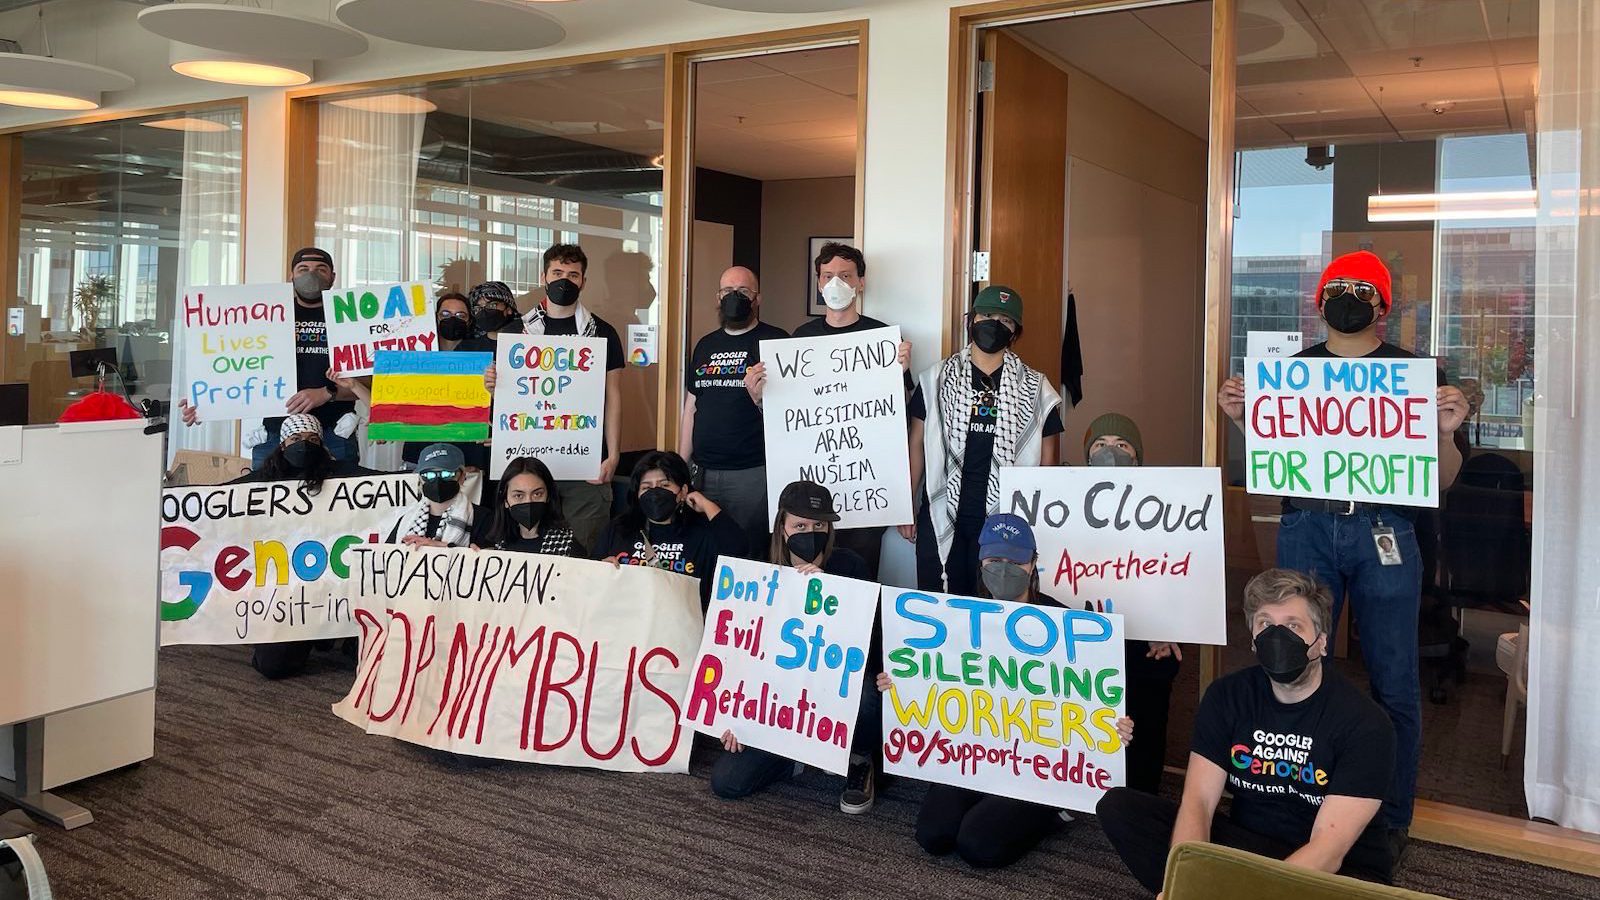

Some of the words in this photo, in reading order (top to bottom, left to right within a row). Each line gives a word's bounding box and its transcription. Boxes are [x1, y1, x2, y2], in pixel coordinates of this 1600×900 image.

[184, 293, 286, 328] Human
[333, 291, 379, 324] NO
[383, 284, 427, 319] AI
[202, 332, 268, 355] Lives
[369, 324, 390, 335] FOR
[508, 342, 595, 372] GOOGLE:
[708, 358, 745, 367] AGAINST
[710, 351, 748, 360] GOOGLER
[775, 348, 815, 379] WE
[830, 339, 897, 374] STAND
[191, 376, 286, 407] Profit
[516, 375, 572, 396] STOP
[722, 379, 747, 388] APARTHE
[813, 382, 848, 396] WITH
[1256, 360, 1310, 391] NO
[1322, 361, 1410, 396] MORE
[499, 413, 597, 432] RETALIATION
[535, 400, 557, 410] the
[784, 394, 897, 432] PALESTINIAN,
[1251, 395, 1429, 439] GENOCIDE
[814, 425, 864, 454] ARAB,
[970, 423, 985, 432] FOR
[505, 443, 590, 460] go/support-eddie
[799, 458, 876, 485] MUSLIM
[1250, 450, 1312, 492] FOR
[1323, 450, 1438, 498] PROFIT
[161, 480, 313, 523] OOGLERS
[328, 476, 423, 512] AGAIN
[832, 487, 889, 514] GLERS
[1010, 489, 1070, 529] No
[1083, 481, 1213, 533] Cloud
[161, 525, 378, 622] Genoc
[441, 552, 561, 605] KURIAN:
[1053, 547, 1192, 596] Apartheid
[715, 564, 780, 607] Don't
[804, 577, 839, 616] Be
[235, 586, 351, 639] go/sit-in
[895, 591, 1114, 664] STOP
[713, 608, 765, 661] Evil,
[775, 617, 865, 698] Stop
[427, 621, 682, 767] NIMBUS
[888, 647, 1124, 708] SILENCING
[686, 653, 848, 749] Retaliation
[889, 682, 1122, 755] WORKERS
[1251, 744, 1310, 765] AGAINST
[1252, 729, 1313, 751] GOOGLER
[884, 727, 1114, 790] go/support-eddie
[1230, 743, 1329, 786] Genocide
[1266, 785, 1286, 794] FOR
